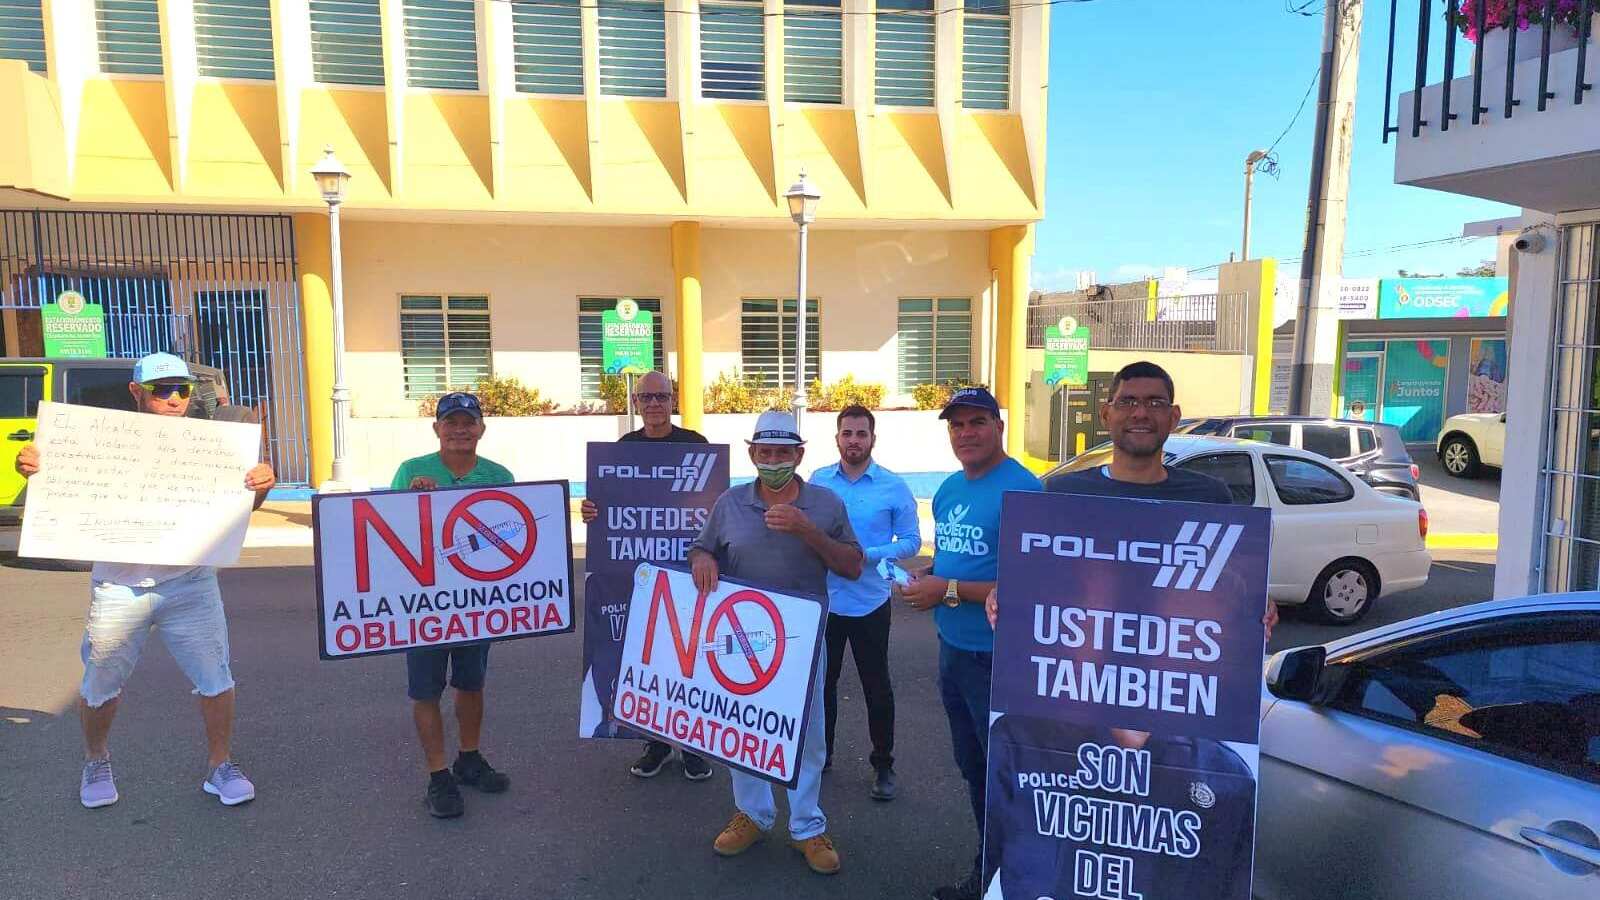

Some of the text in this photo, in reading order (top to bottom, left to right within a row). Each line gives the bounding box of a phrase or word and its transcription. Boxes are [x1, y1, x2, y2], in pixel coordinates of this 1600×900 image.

[46, 323, 102, 333] RESERVADO
[1397, 386, 1440, 398] Juntos
[598, 465, 700, 480] POLICIA
[607, 506, 708, 531] USTEDES
[607, 536, 697, 561] TAMBIE
[1020, 532, 1207, 568] POLICIA
[333, 578, 563, 621] A LA VACUNACION
[601, 602, 627, 616] POLIC
[335, 602, 564, 652] OBLIGATORIA
[1033, 604, 1222, 662] USTEDES
[623, 666, 796, 741] A LA VACUNACION
[1030, 655, 1218, 716] TAMBIEN
[620, 691, 786, 777] OBLIGATORIA
[1018, 772, 1079, 790] POLICE
[1077, 742, 1151, 797] SON
[1033, 789, 1202, 858] VICTIMAS
[1074, 849, 1143, 900] DEL
